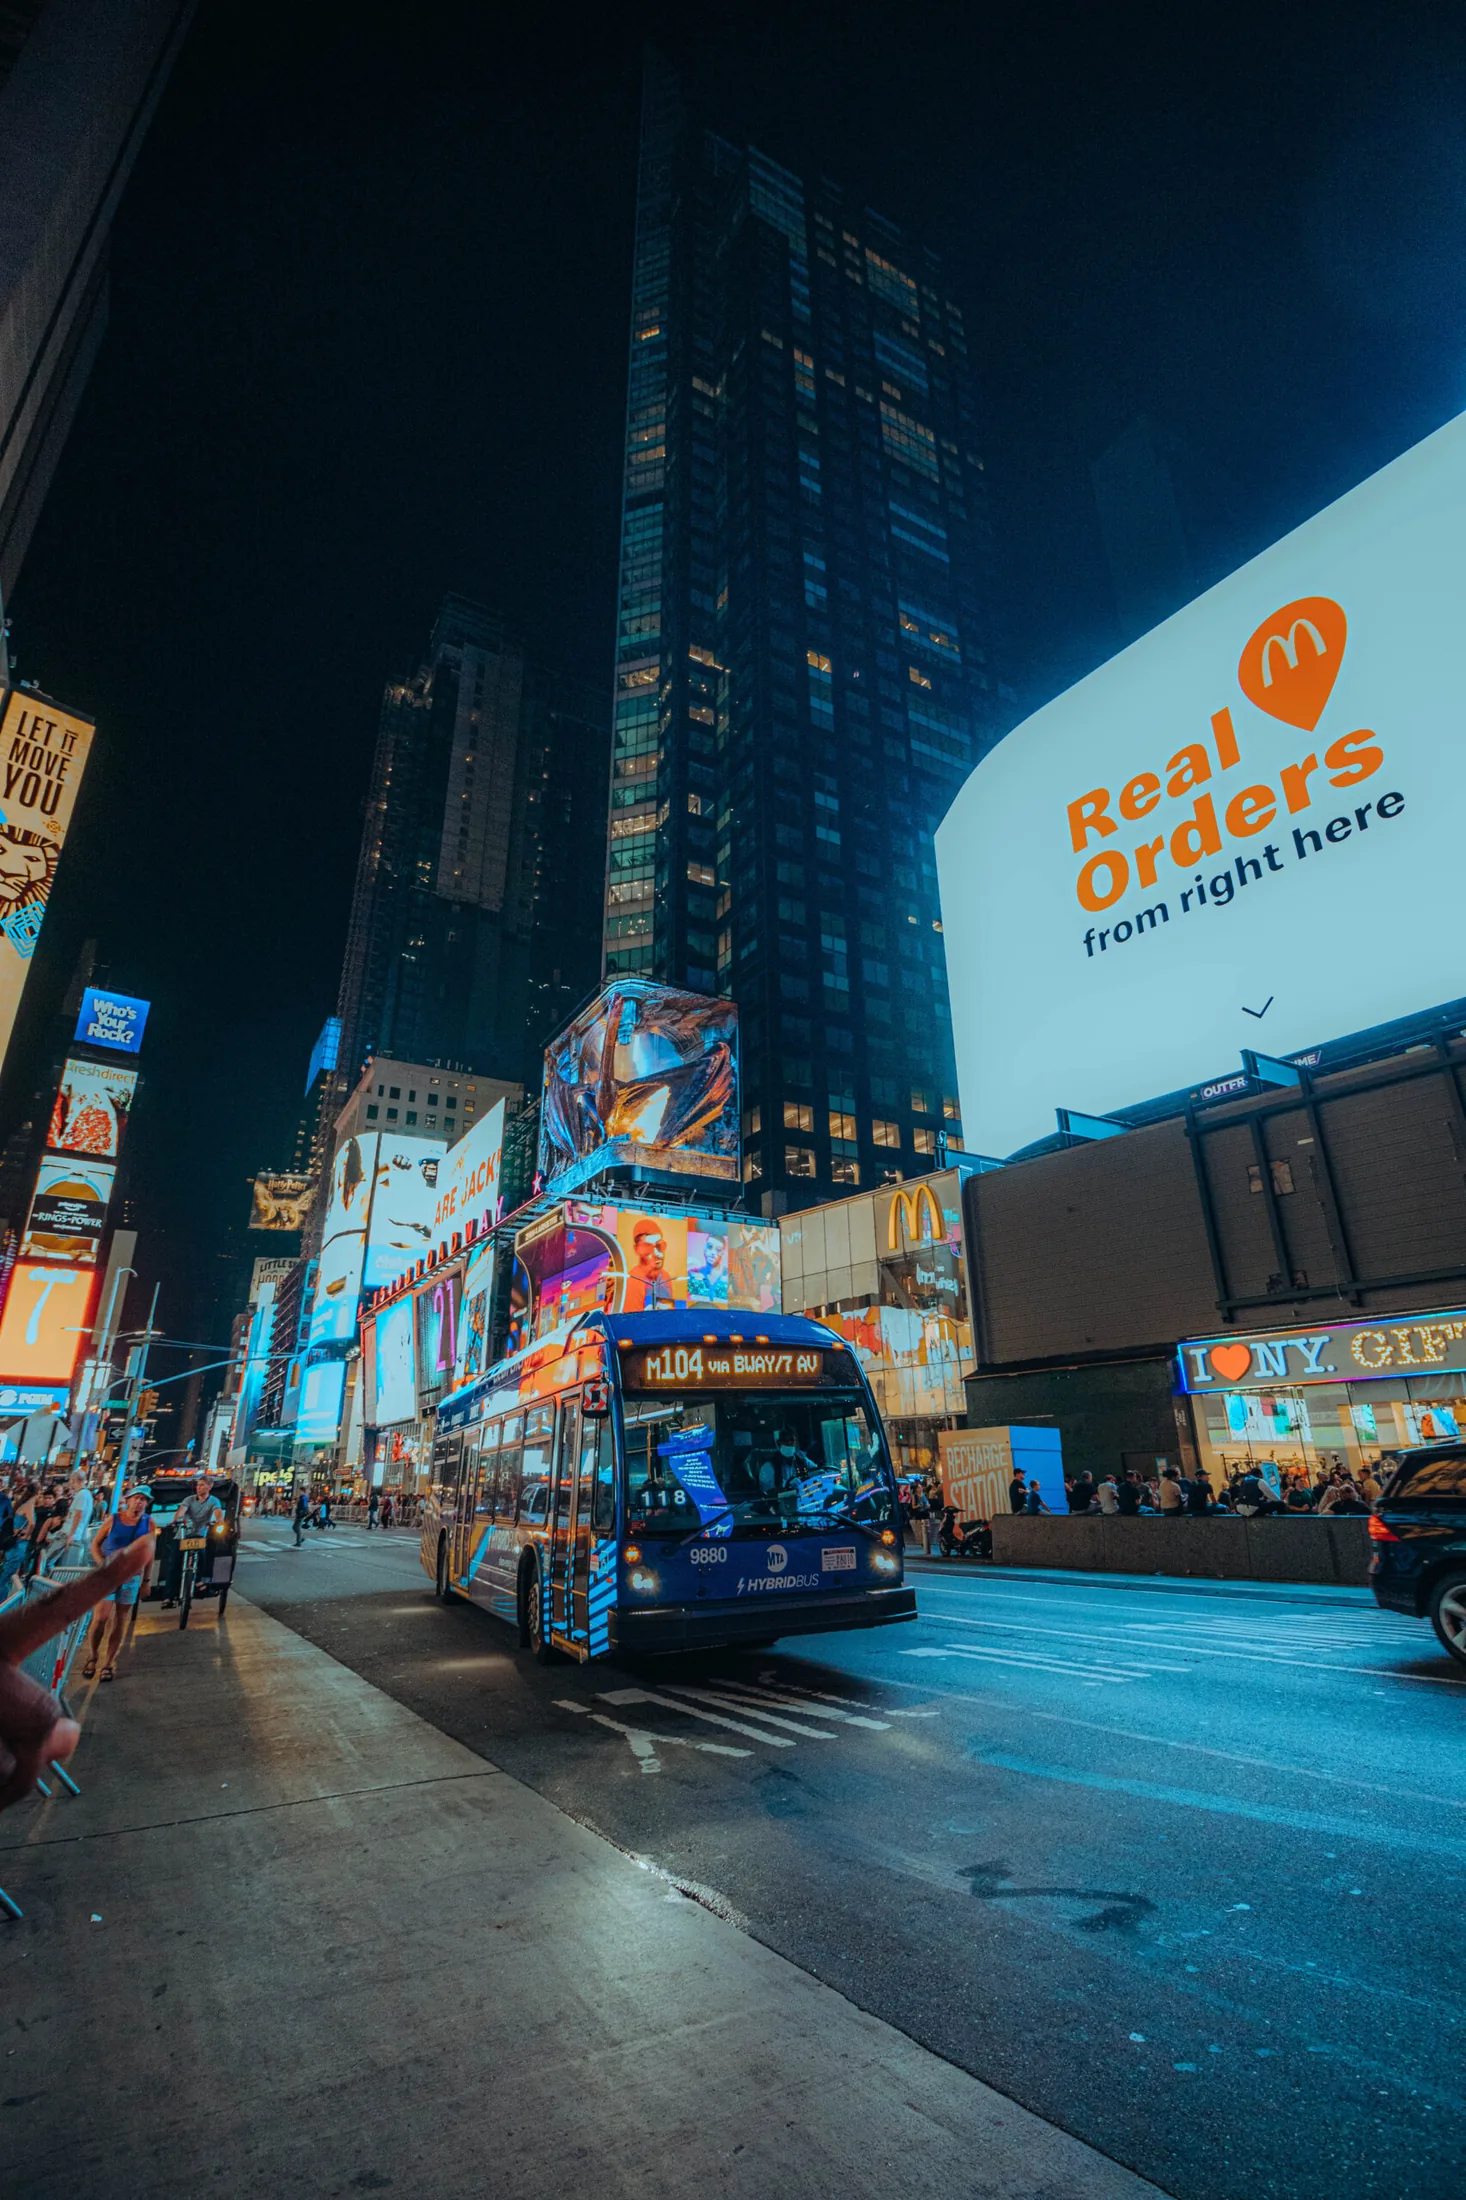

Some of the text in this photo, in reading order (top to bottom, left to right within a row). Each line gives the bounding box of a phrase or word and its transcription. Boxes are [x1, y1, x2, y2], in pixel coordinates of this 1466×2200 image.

[16, 710, 78, 753] LET IT
[8, 737, 71, 782] MOVE
[3, 763, 64, 816] YOU
[1066, 706, 1241, 855] Real
[1075, 728, 1384, 913] Orders
[1082, 791, 1406, 958] from right here
[93, 999, 138, 1021] Who's
[97, 1012, 129, 1030] Your
[87, 1023, 135, 1044] Rock?
[66, 1060, 137, 1085] freshdirect
[38, 1211, 68, 1224] RINGS
[70, 1216, 103, 1228] POWER
[260, 1259, 287, 1273] LITTLE
[646, 1348, 704, 1381] M104
[733, 1354, 793, 1374] BWAY/7
[796, 1354, 818, 1374] AV
[1189, 1347, 1214, 1383] I
[946, 1443, 1009, 1481] RECHARGE
[949, 1468, 1013, 1525] STATION
[689, 1546, 728, 1565] 9880
